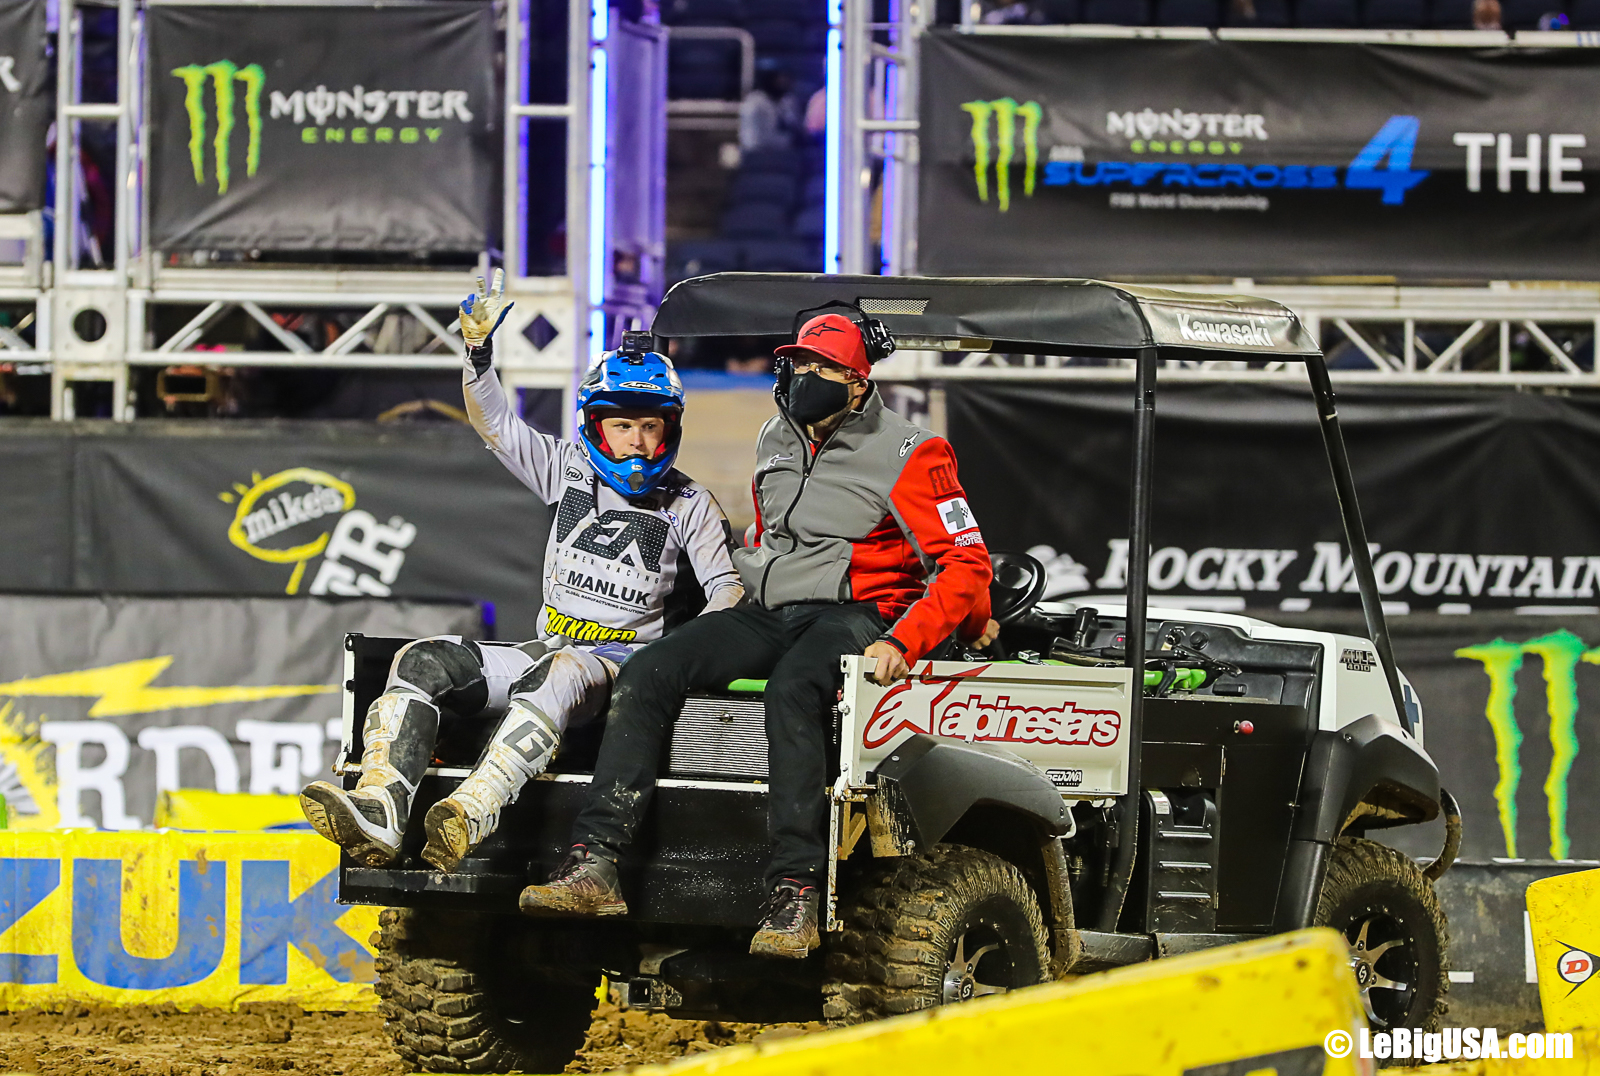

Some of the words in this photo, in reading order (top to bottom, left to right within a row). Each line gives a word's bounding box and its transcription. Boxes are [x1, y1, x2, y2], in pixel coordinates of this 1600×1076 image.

[270, 85, 473, 125] MONSTER
[302, 127, 442, 144] ENERGY
[1107, 108, 1268, 140] MONSTER
[1345, 115, 1431, 206] 4
[1453, 132, 1586, 193] THE
[1176, 313, 1275, 347] Kawasaki
[567, 570, 651, 606] MANLUK
[605, 563, 660, 584] RACING
[1340, 649, 1376, 666] MULE
[1347, 664, 1370, 672] 4010
[938, 694, 1121, 747] alpinestars
